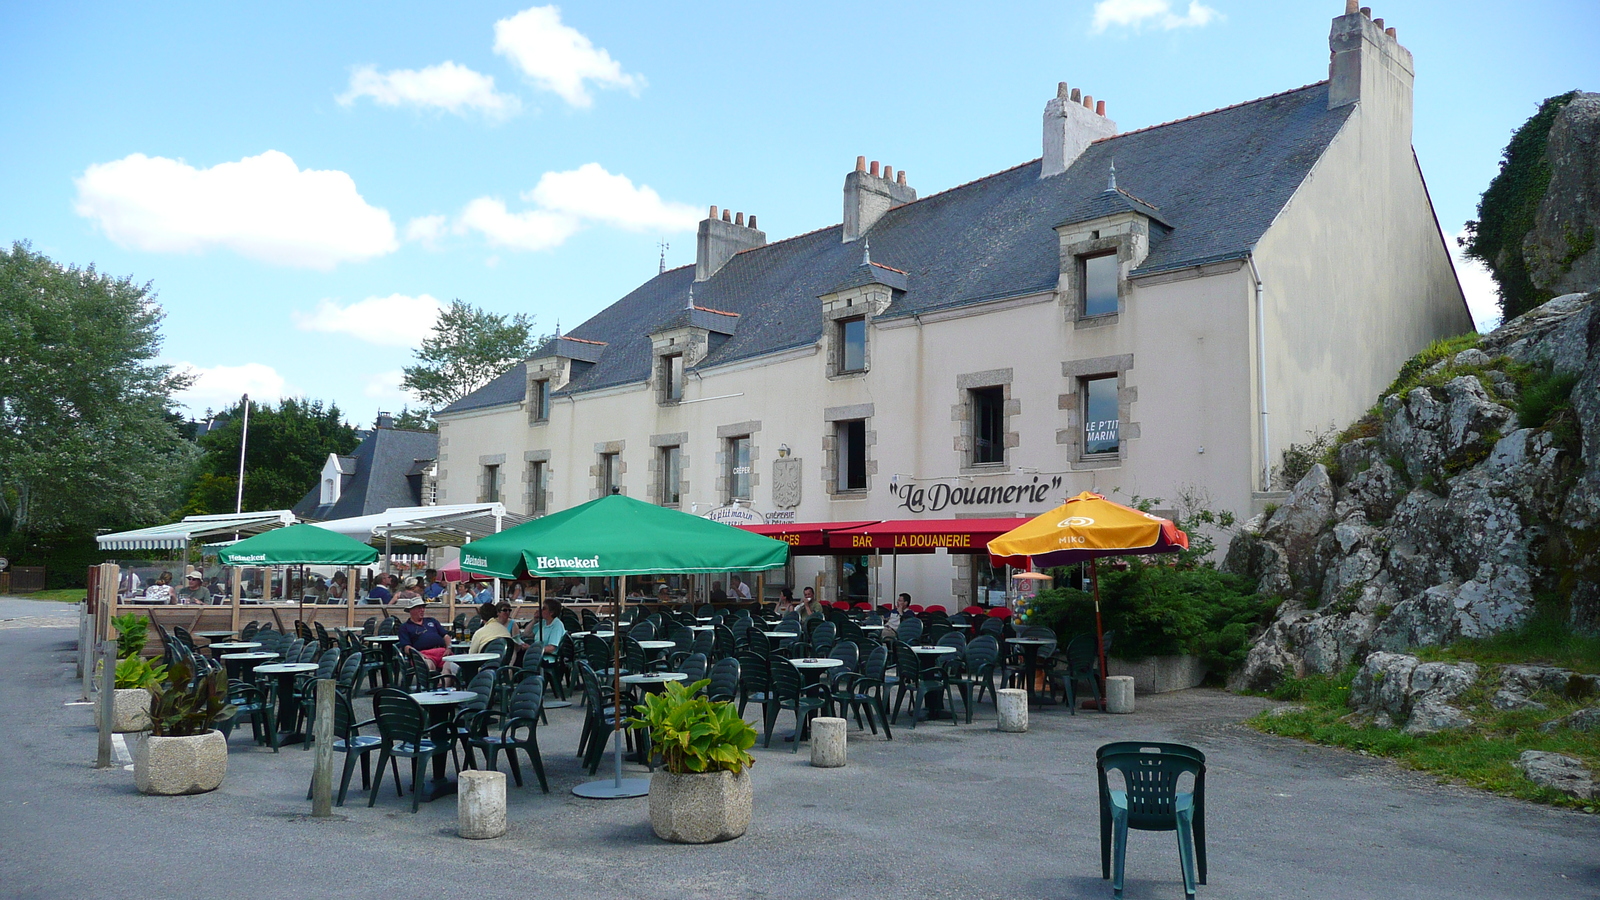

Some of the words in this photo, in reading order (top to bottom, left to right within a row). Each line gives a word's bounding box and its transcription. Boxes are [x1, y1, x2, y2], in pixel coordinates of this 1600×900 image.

[1086, 422, 1096, 431] LE
[1098, 420, 1119, 430] P'TIT
[1087, 431, 1116, 441] MARIN
[852, 535, 873, 547] BAR
[894, 535, 907, 547] LA
[909, 534, 971, 547] DOUANERIE
[1058, 536, 1085, 544] MIKO
[228, 554, 266, 562] Heineken
[463, 554, 488, 568] Heineken
[536, 555, 600, 569] Heineken
